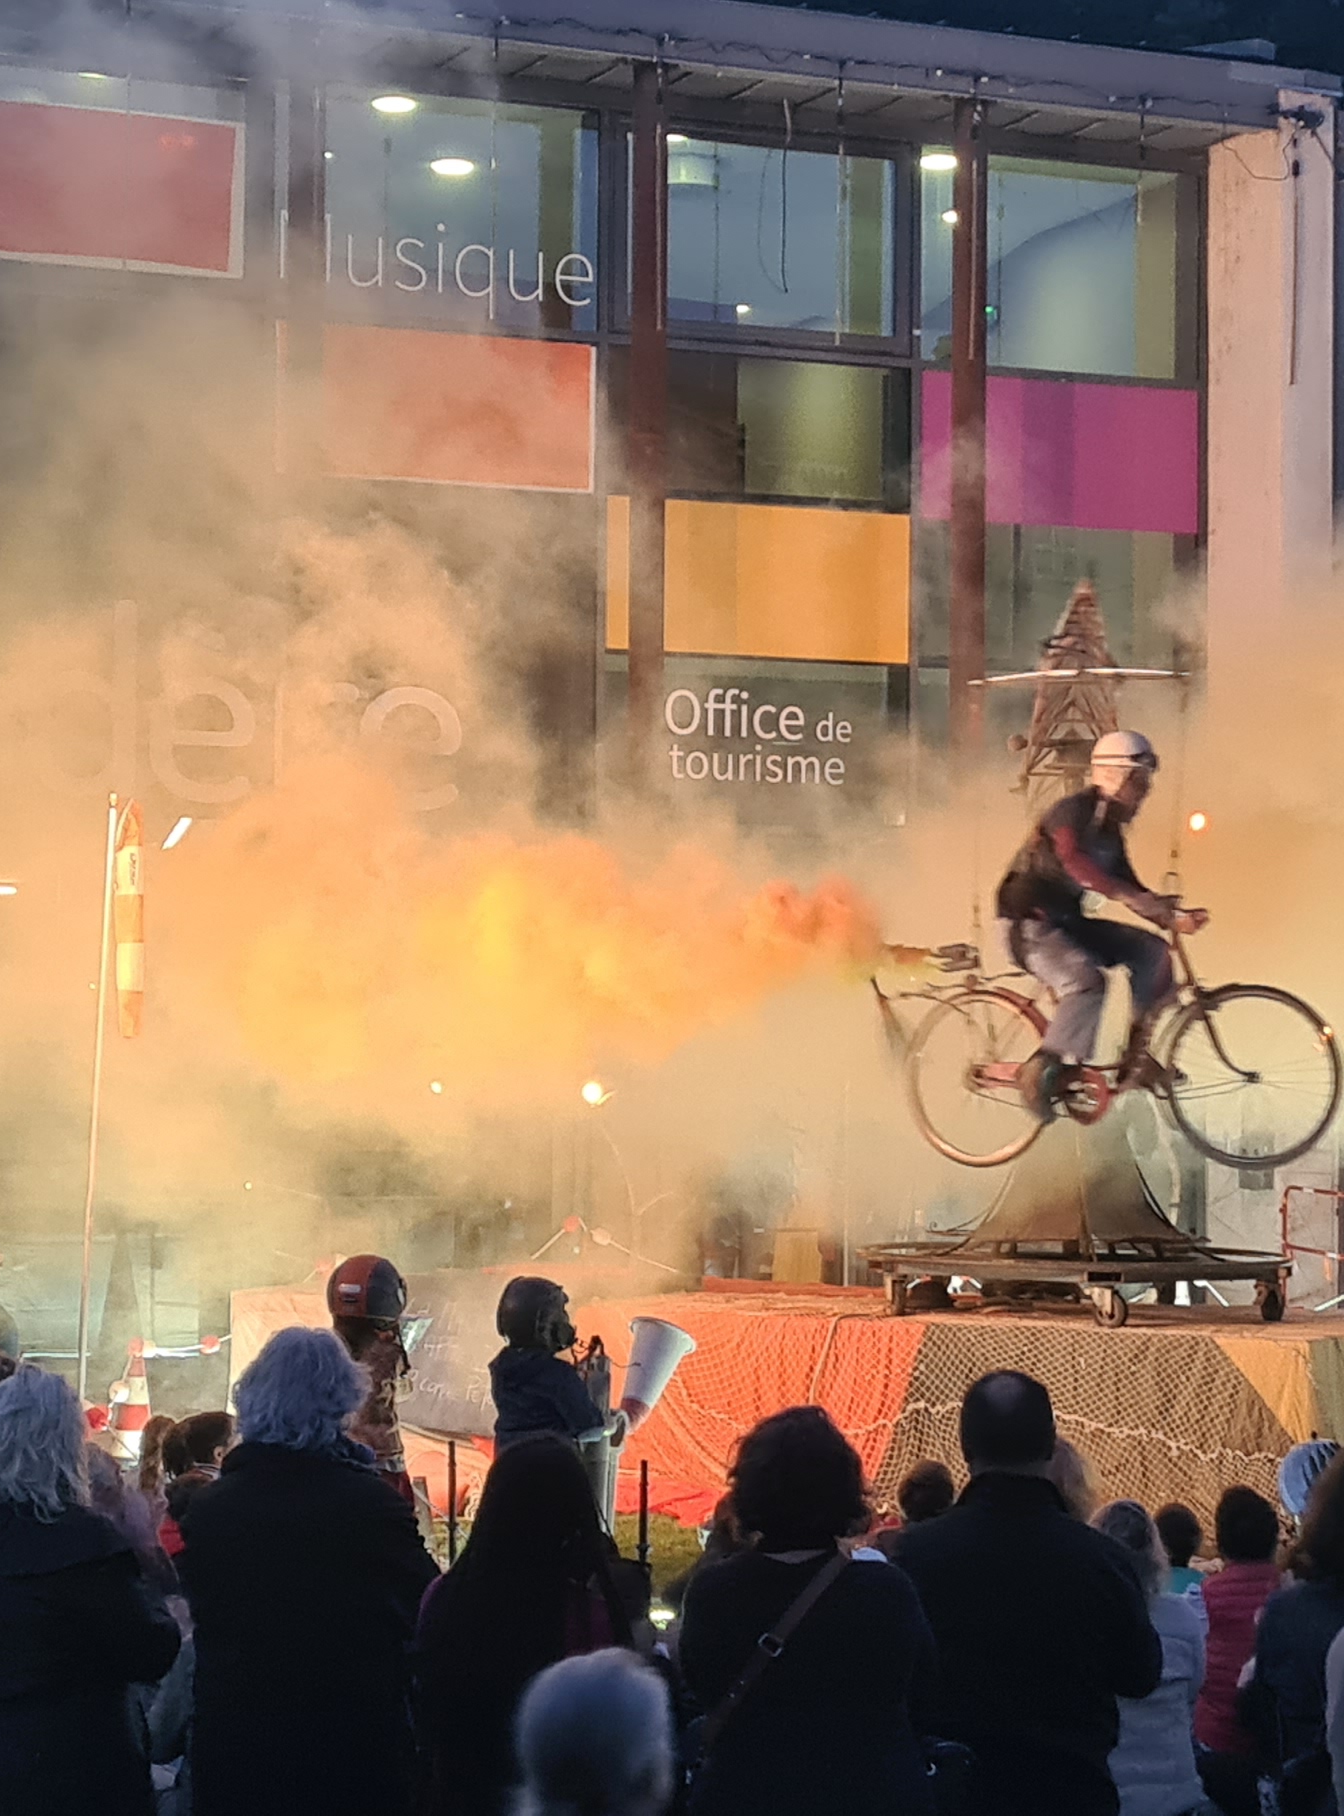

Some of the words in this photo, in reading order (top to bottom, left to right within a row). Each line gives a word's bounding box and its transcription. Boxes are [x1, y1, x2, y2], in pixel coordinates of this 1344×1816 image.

[664, 687, 805, 741] Office
[815, 711, 853, 744] de
[668, 743, 846, 786] tourisme
